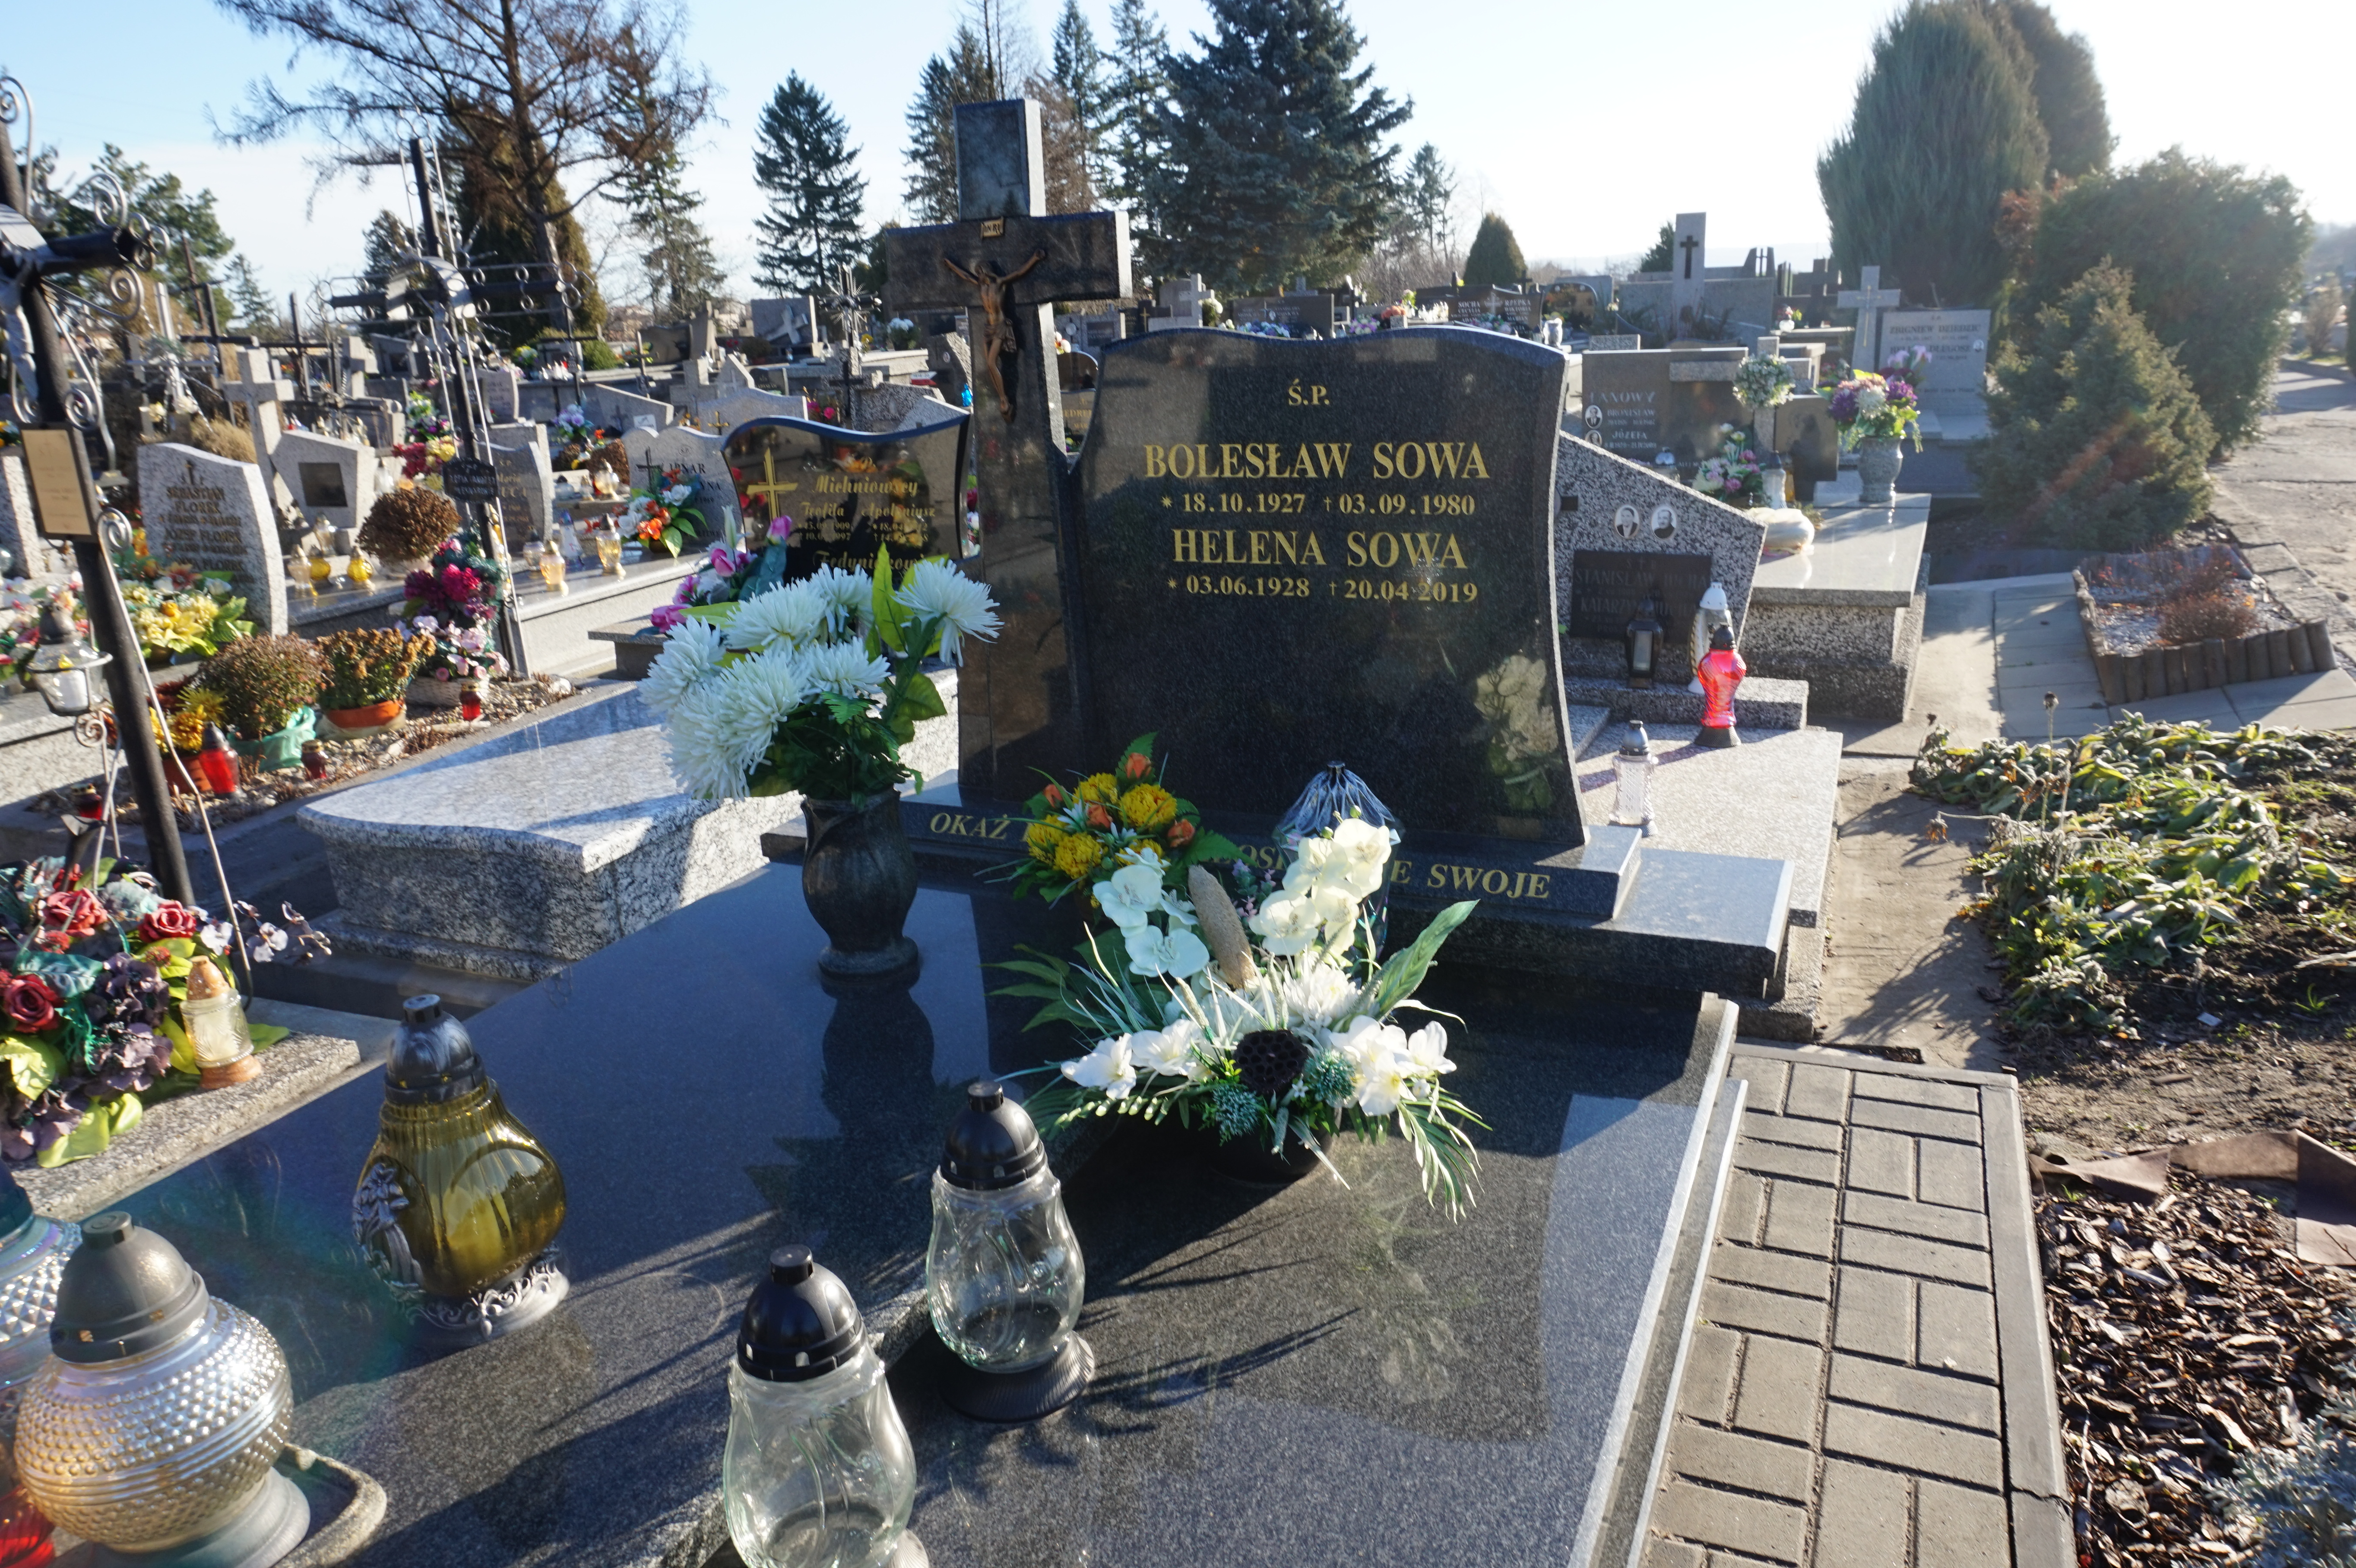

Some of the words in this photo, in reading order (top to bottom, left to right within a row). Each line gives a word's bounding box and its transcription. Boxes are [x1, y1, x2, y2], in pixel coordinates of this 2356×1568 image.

[1143, 443, 1352, 478] BOLESŁAW
[1373, 441, 1490, 479] SOWA
[1183, 493, 1306, 513] 18.10.1927
[1339, 493, 1475, 515] 03.09.1980
[1173, 529, 1326, 565] HELENA
[1347, 531, 1467, 569] SOWA
[1186, 575, 1310, 597] 03.06.1928
[930, 812, 1011, 839] OKAŻ
[1428, 864, 1550, 899] SWOJE
